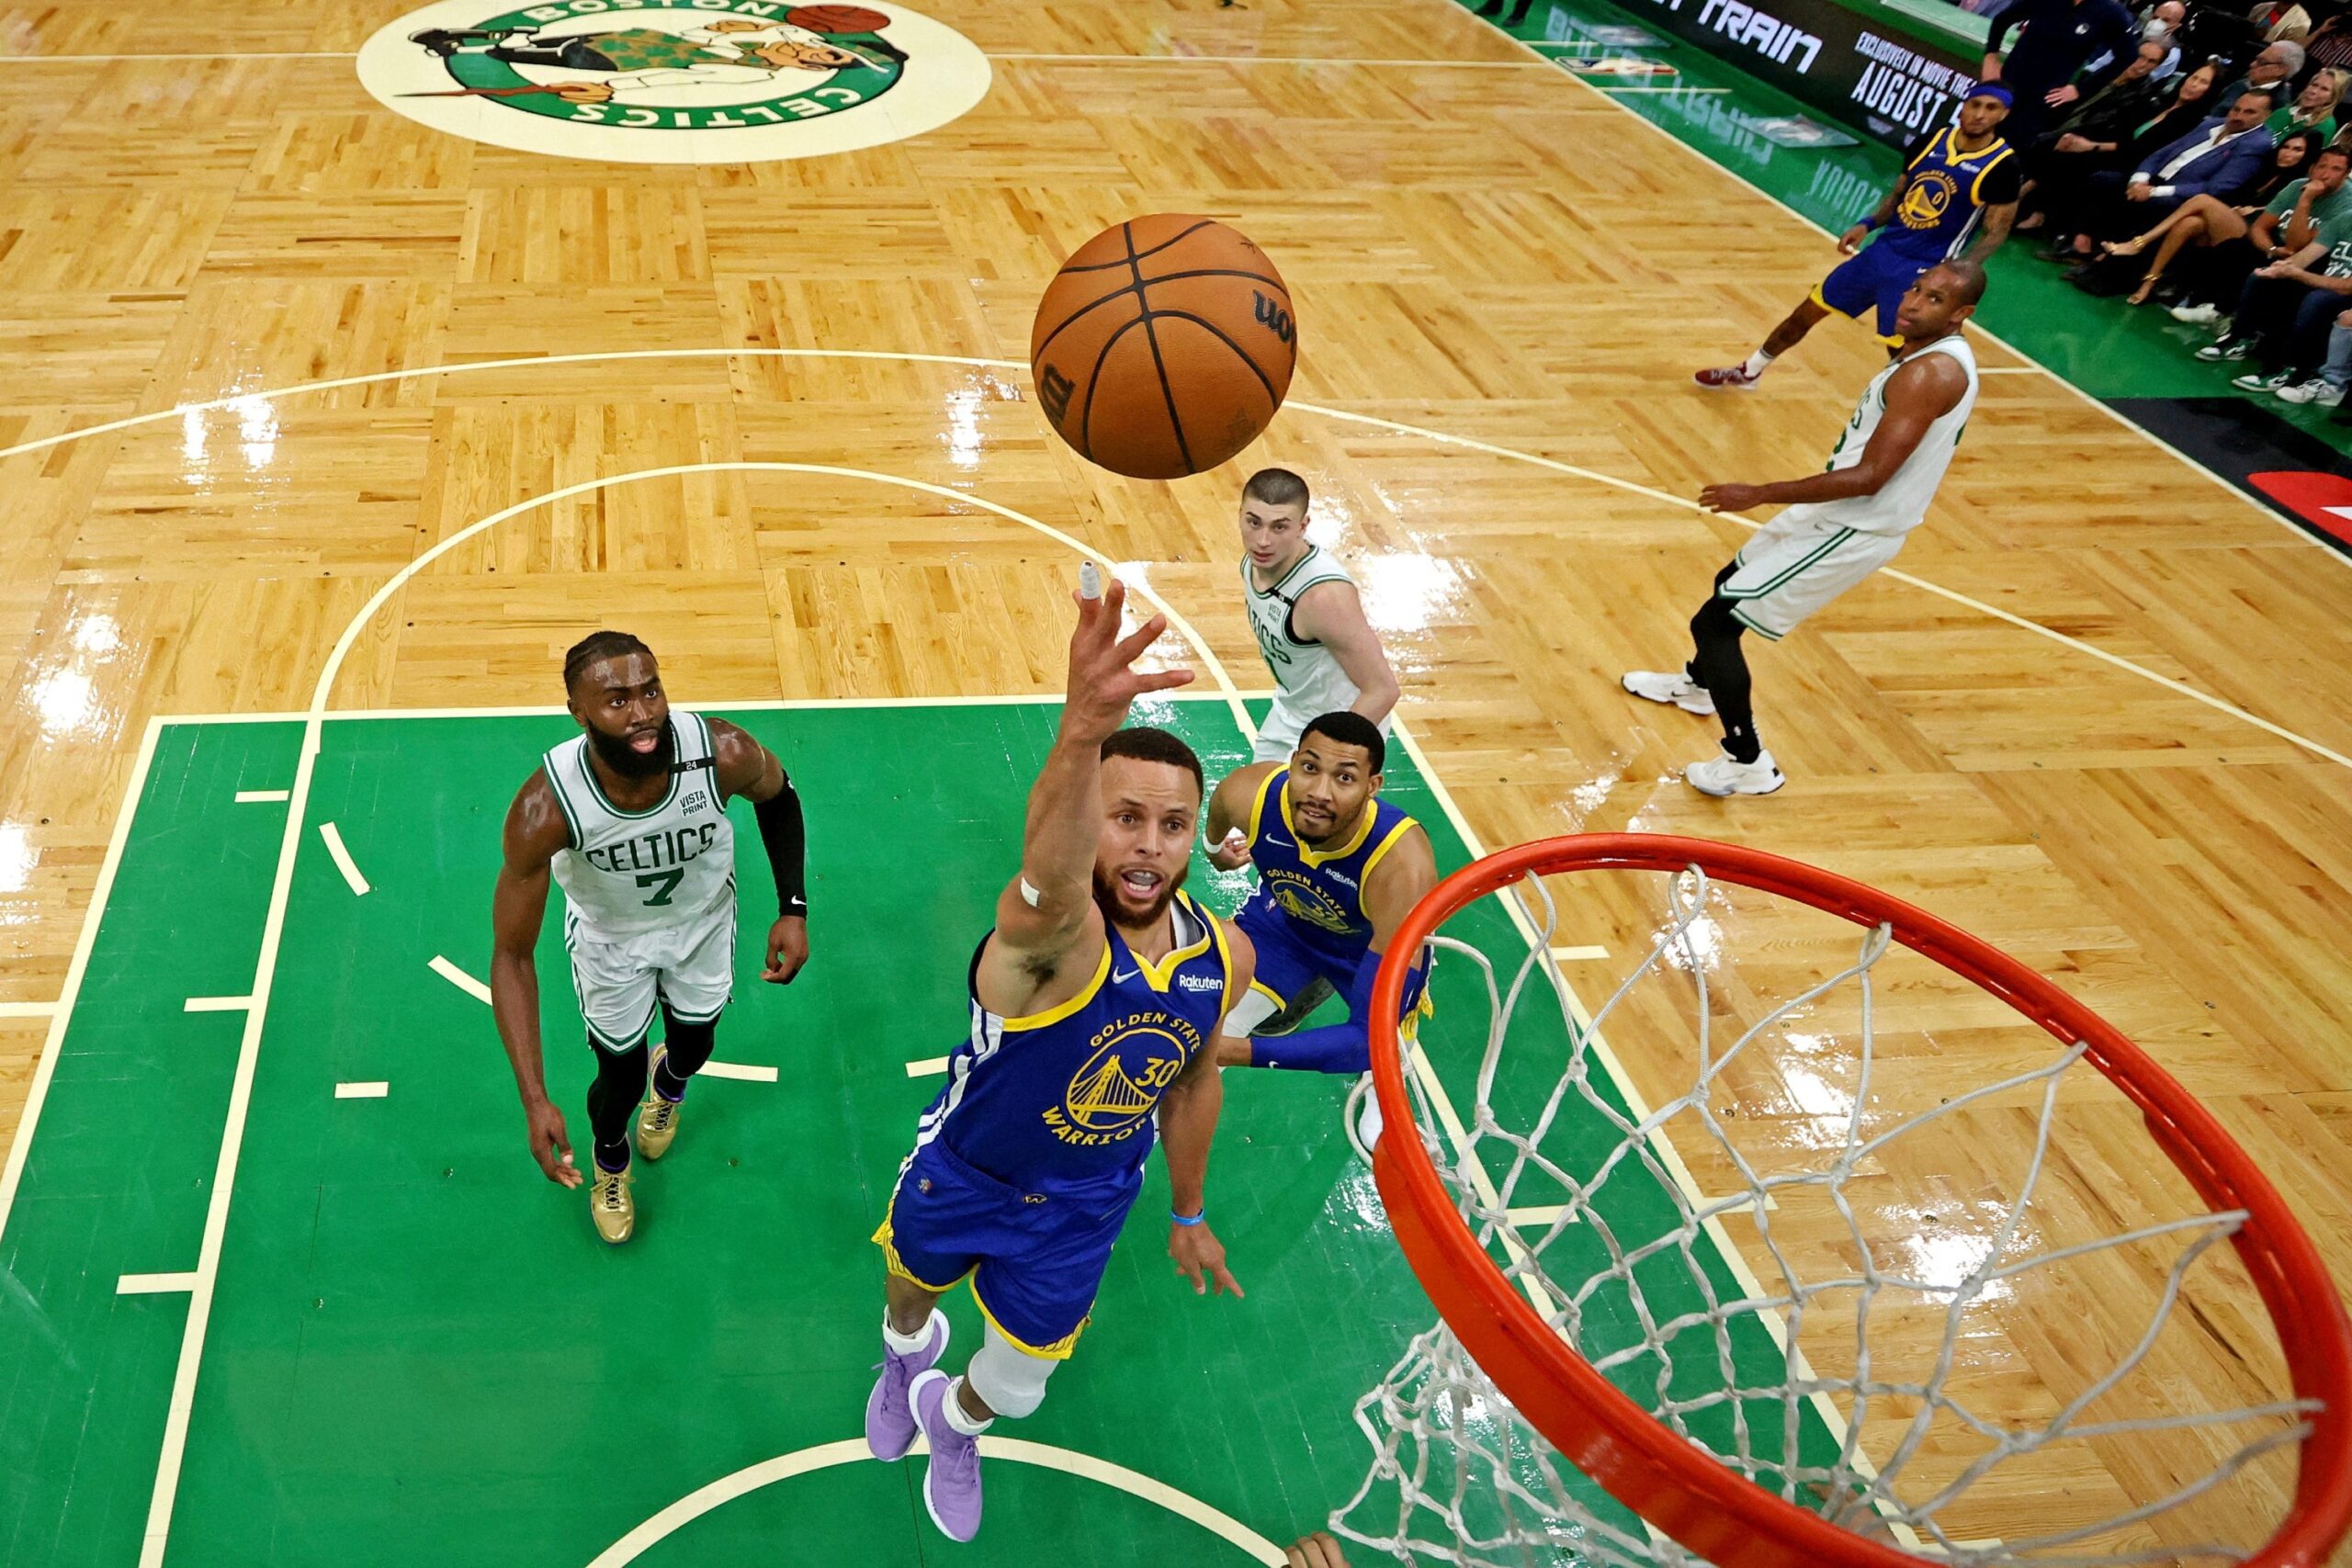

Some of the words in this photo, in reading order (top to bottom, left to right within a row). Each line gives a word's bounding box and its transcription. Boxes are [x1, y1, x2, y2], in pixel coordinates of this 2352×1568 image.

[523, 0, 778, 21] BOSTON
[570, 87, 862, 128] CELTICS
[1850, 61, 1948, 134] AUGUST
[1931, 191, 1945, 206] 0
[685, 761, 698, 771] 24
[680, 790, 707, 808] VISTA
[683, 800, 707, 817] PRINT
[585, 822, 717, 872] CELTICS
[635, 866, 684, 907] 7
[1267, 868, 1312, 886] GOLDEN
[1179, 974, 1223, 991] Rakuten
[1090, 1012, 1167, 1047] GOLDEN
[1170, 1018, 1202, 1054] STATE
[1135, 1057, 1181, 1089] 30
